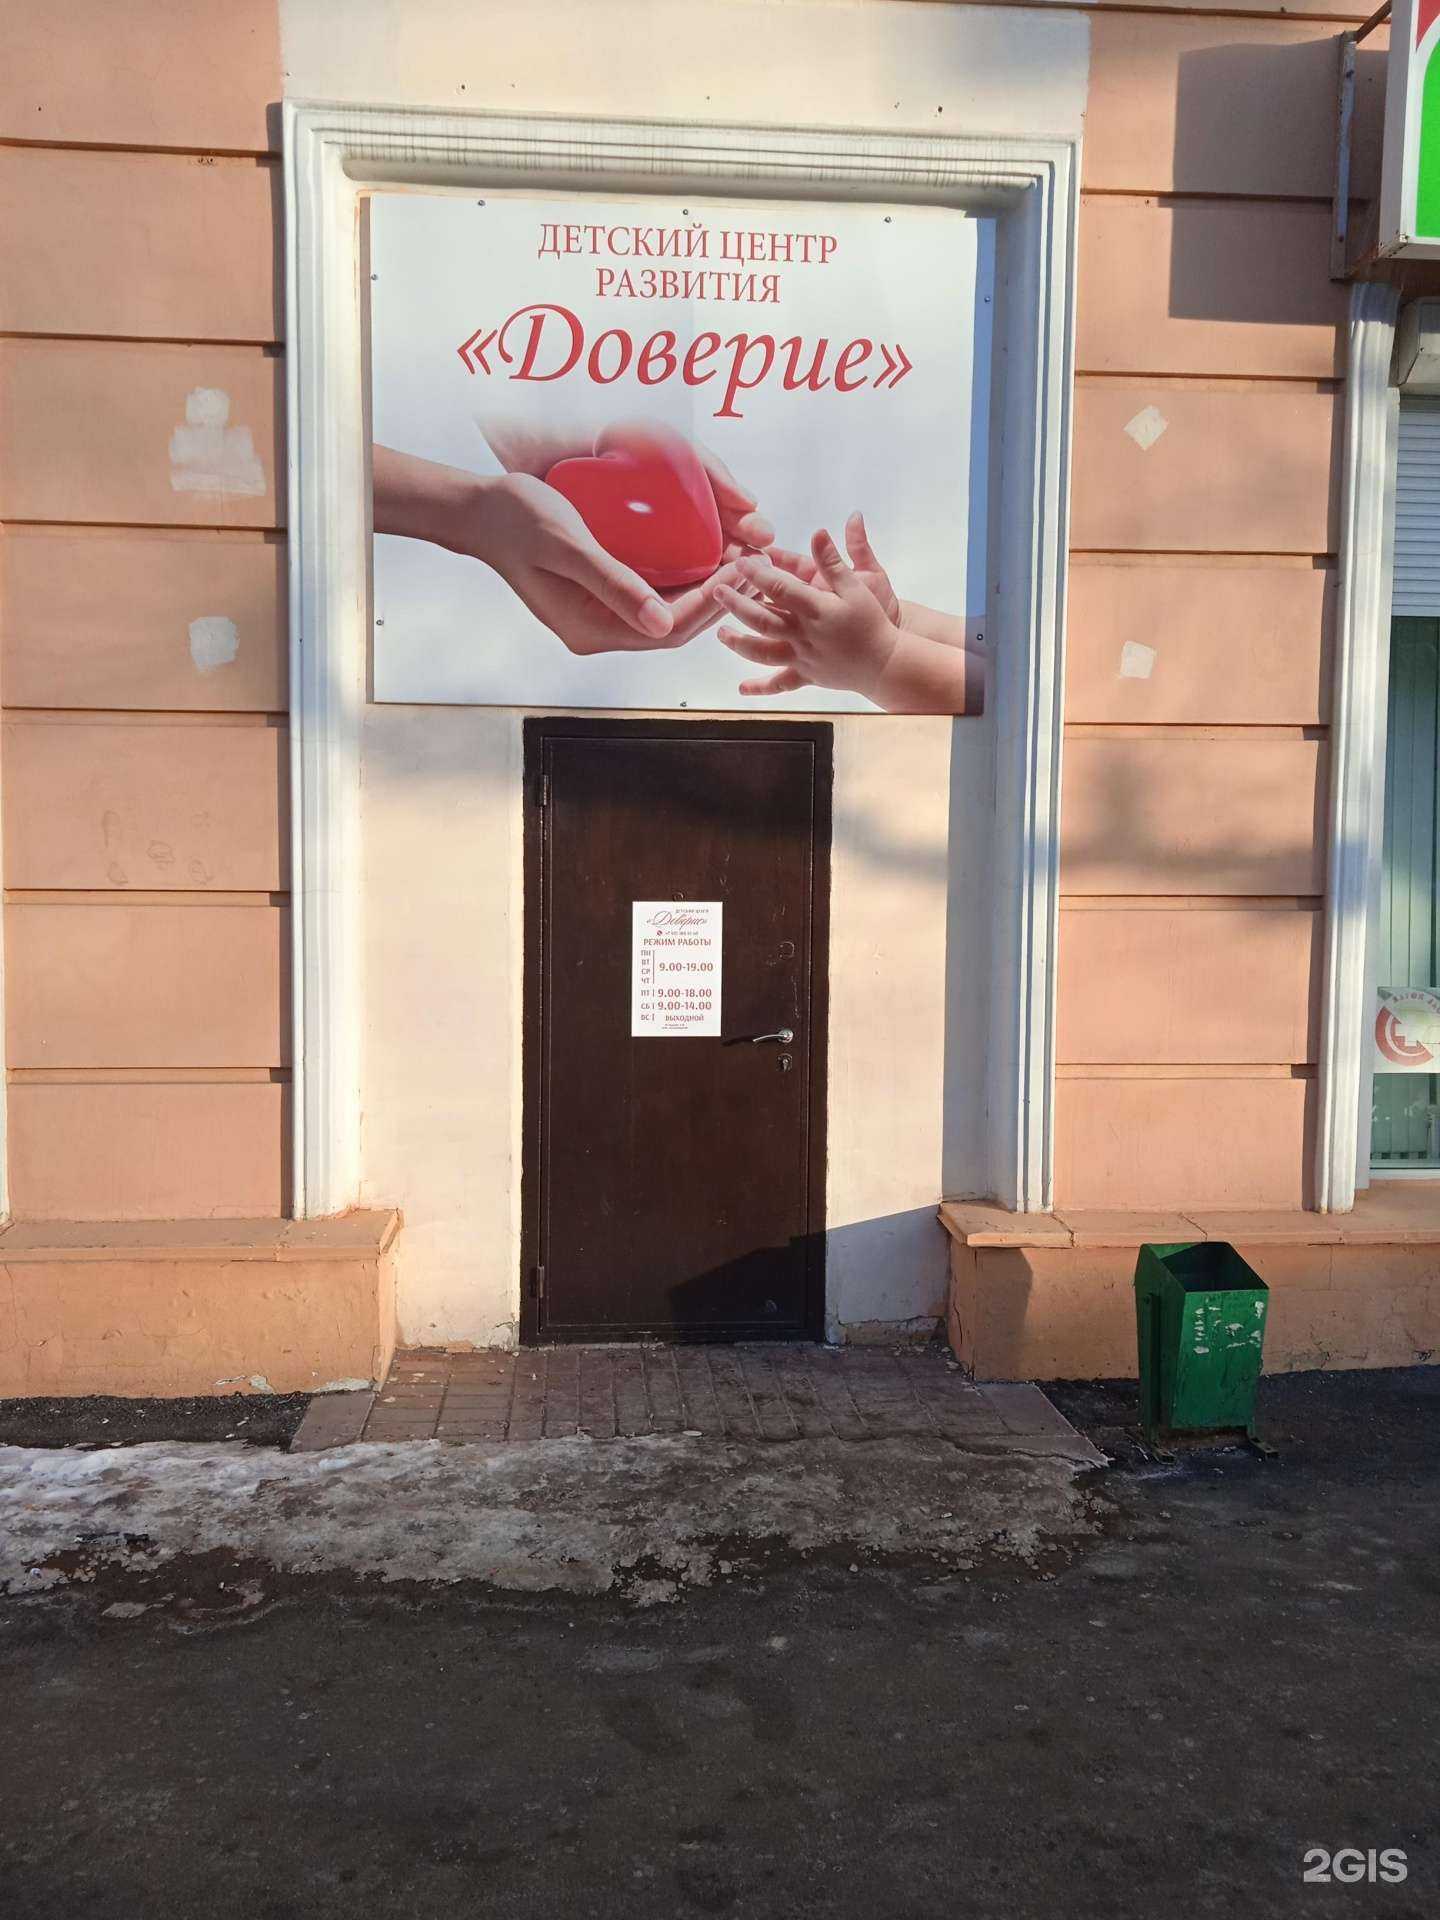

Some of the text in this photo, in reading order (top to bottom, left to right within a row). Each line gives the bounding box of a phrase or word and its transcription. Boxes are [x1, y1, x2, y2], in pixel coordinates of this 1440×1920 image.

[537, 222, 839, 265] ДЕТСКИЙ ЦЕНТР
[595, 268, 781, 304] РАЗВИТИЯ
[456, 303, 914, 419] «Доверие»
[659, 962, 714, 972] 9.00-19.00
[657, 988, 712, 998] 9.00-18.00
[657, 1001, 712, 1011] 9.00-14.00
